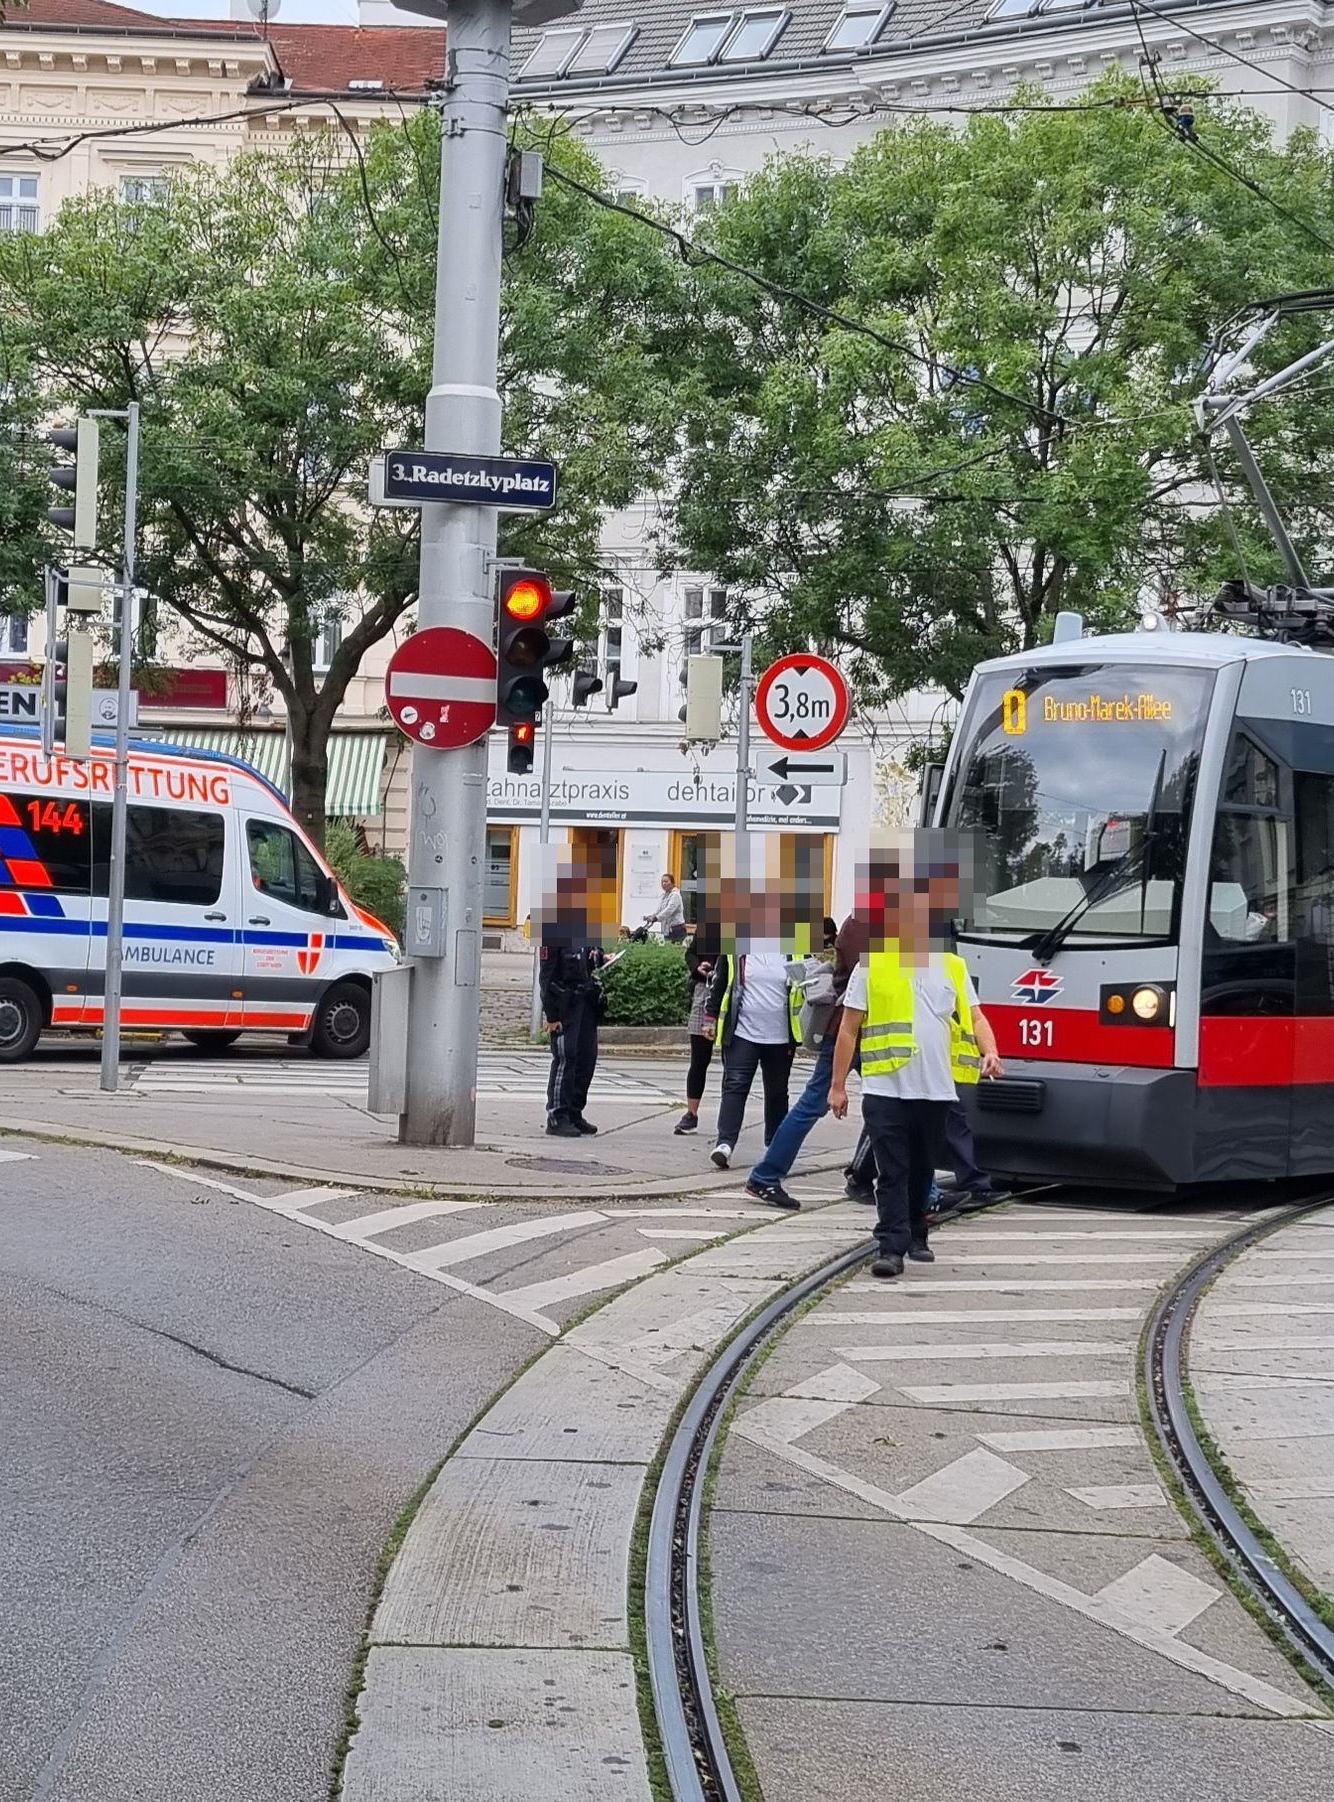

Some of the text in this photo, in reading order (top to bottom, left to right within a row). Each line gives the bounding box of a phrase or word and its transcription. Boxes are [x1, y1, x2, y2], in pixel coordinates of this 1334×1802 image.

[1043, 694, 1172, 721] Bruno-Marek-Allee
[1290, 688, 1312, 715] 131
[487, 777, 630, 804] ahnaztpraxis
[667, 780, 766, 803] dentaior
[27, 799, 83, 835] 144
[121, 945, 216, 965] MBULANCE
[1019, 1018, 1053, 1047] 131
